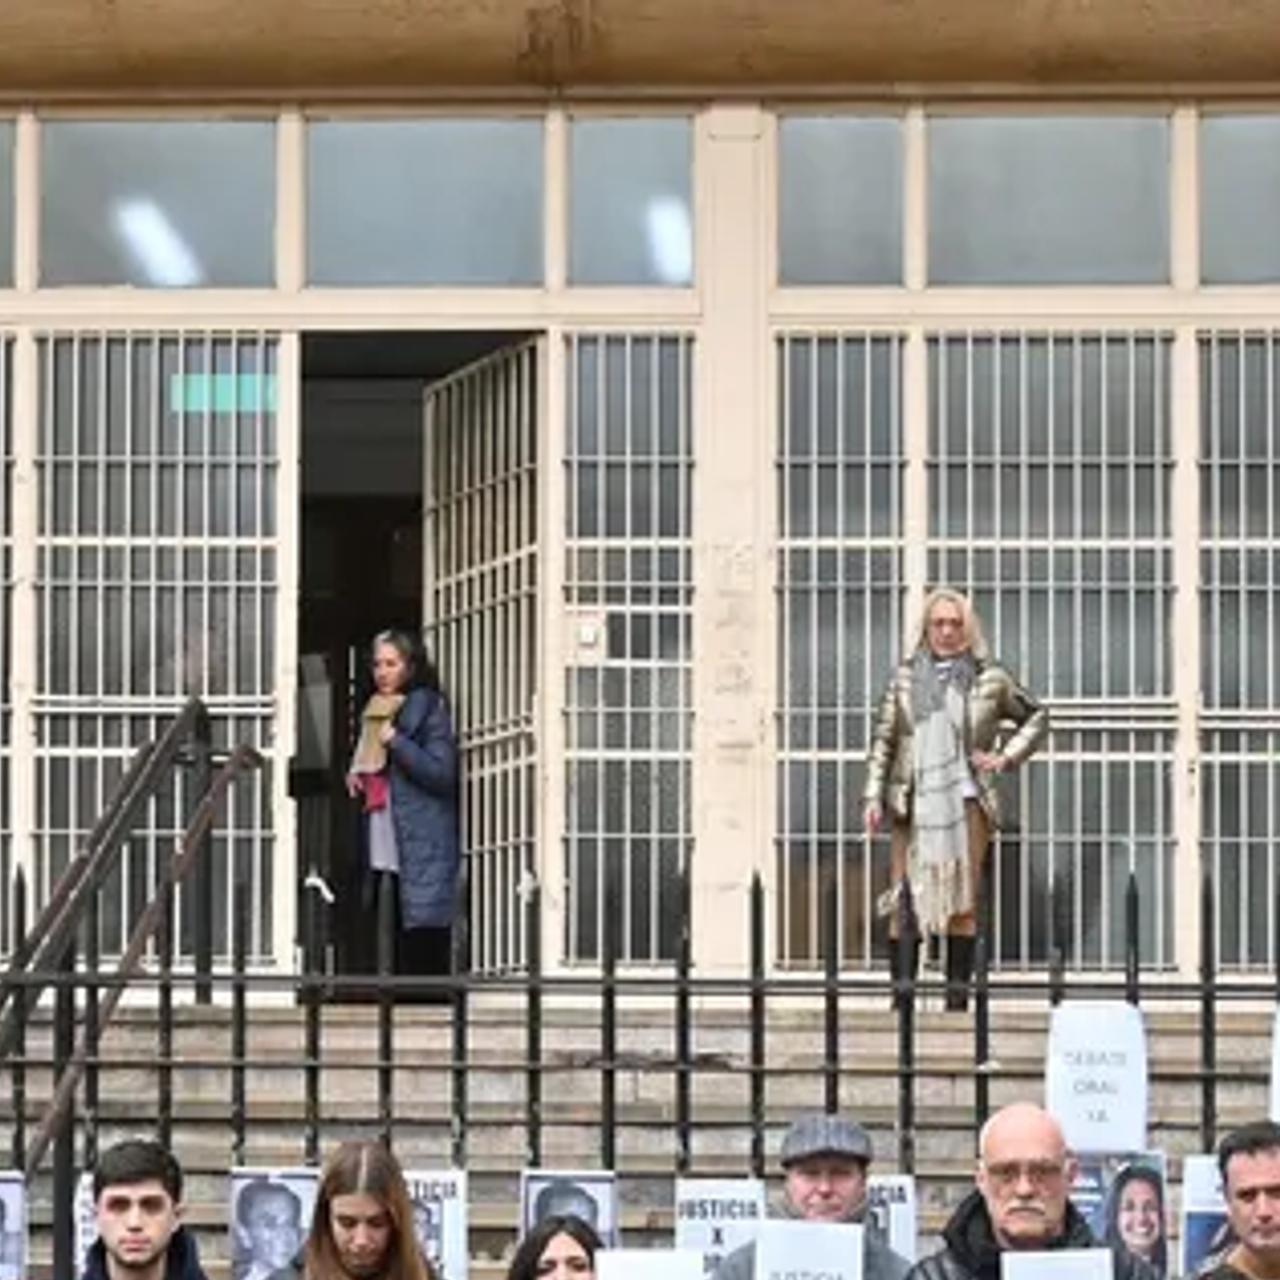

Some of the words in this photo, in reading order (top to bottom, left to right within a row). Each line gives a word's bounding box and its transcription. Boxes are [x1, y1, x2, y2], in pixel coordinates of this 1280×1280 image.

[1072, 1079, 1118, 1096] ORAL
[412, 1180, 457, 1199] TICIA
[680, 1199, 758, 1219] JUSTICIA
[712, 1228, 723, 1245] X
